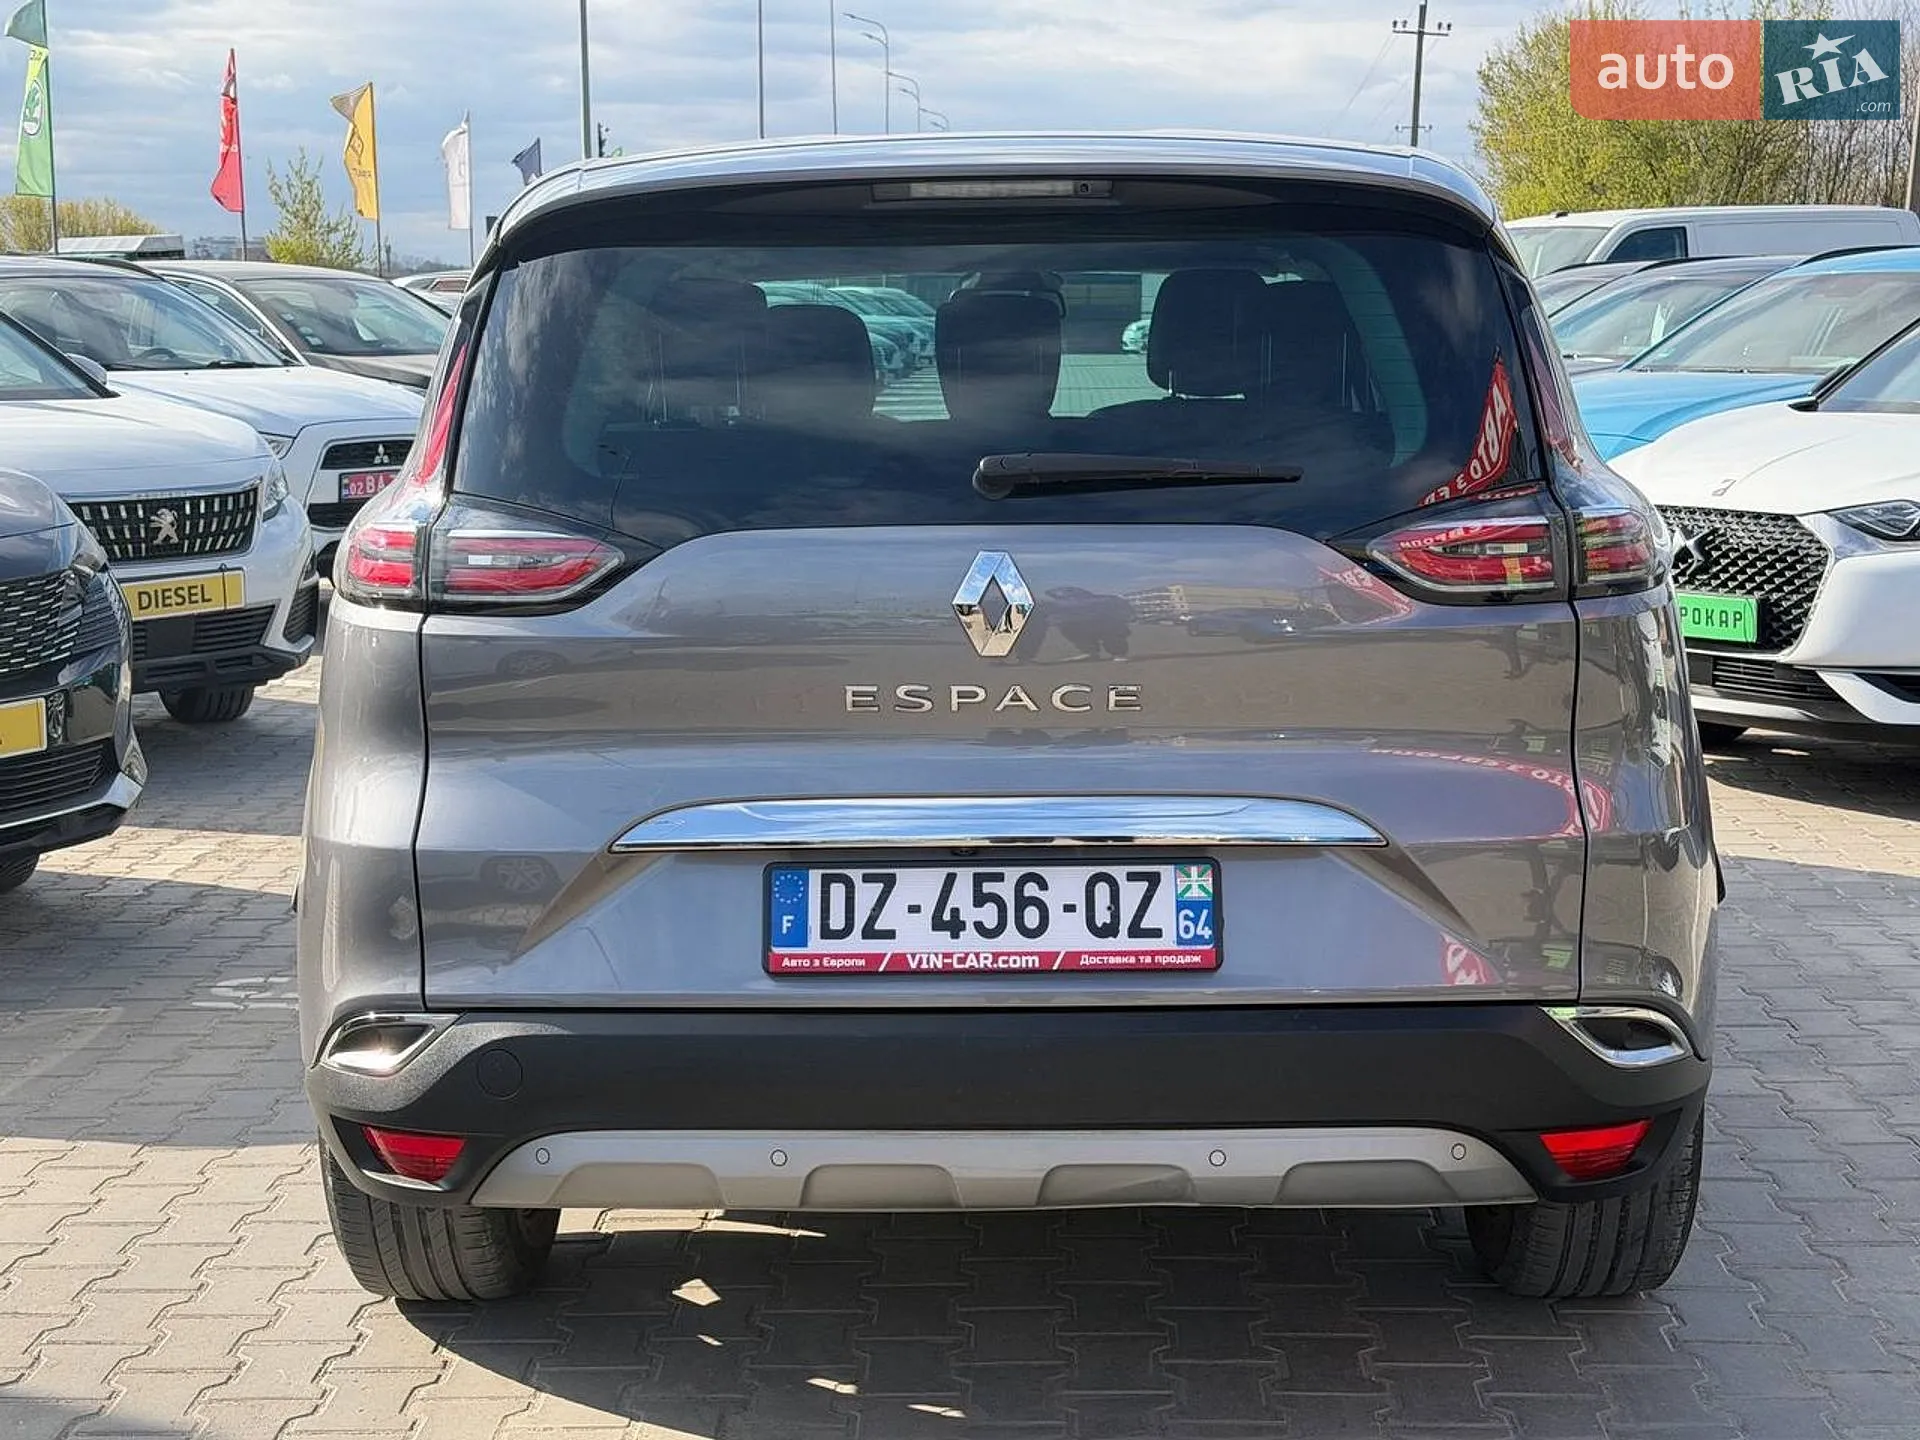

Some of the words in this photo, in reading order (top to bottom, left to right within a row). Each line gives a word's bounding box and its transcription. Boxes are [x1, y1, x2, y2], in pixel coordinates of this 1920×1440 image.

[137, 584, 212, 610] DIESEL
[1680, 606, 1743, 629] РОКАР
[843, 684, 1142, 713] ESPACE
[819, 871, 1163, 940] DZ-456-QZ
[781, 916, 794, 934] F
[1178, 908, 1212, 940] 64
[782, 957, 810, 967] Авто
[906, 952, 1040, 970] VIN-CAR.com
[1080, 955, 1135, 966] Доставка
[1138, 955, 1152, 964] та
[1155, 954, 1202, 966] продаж
